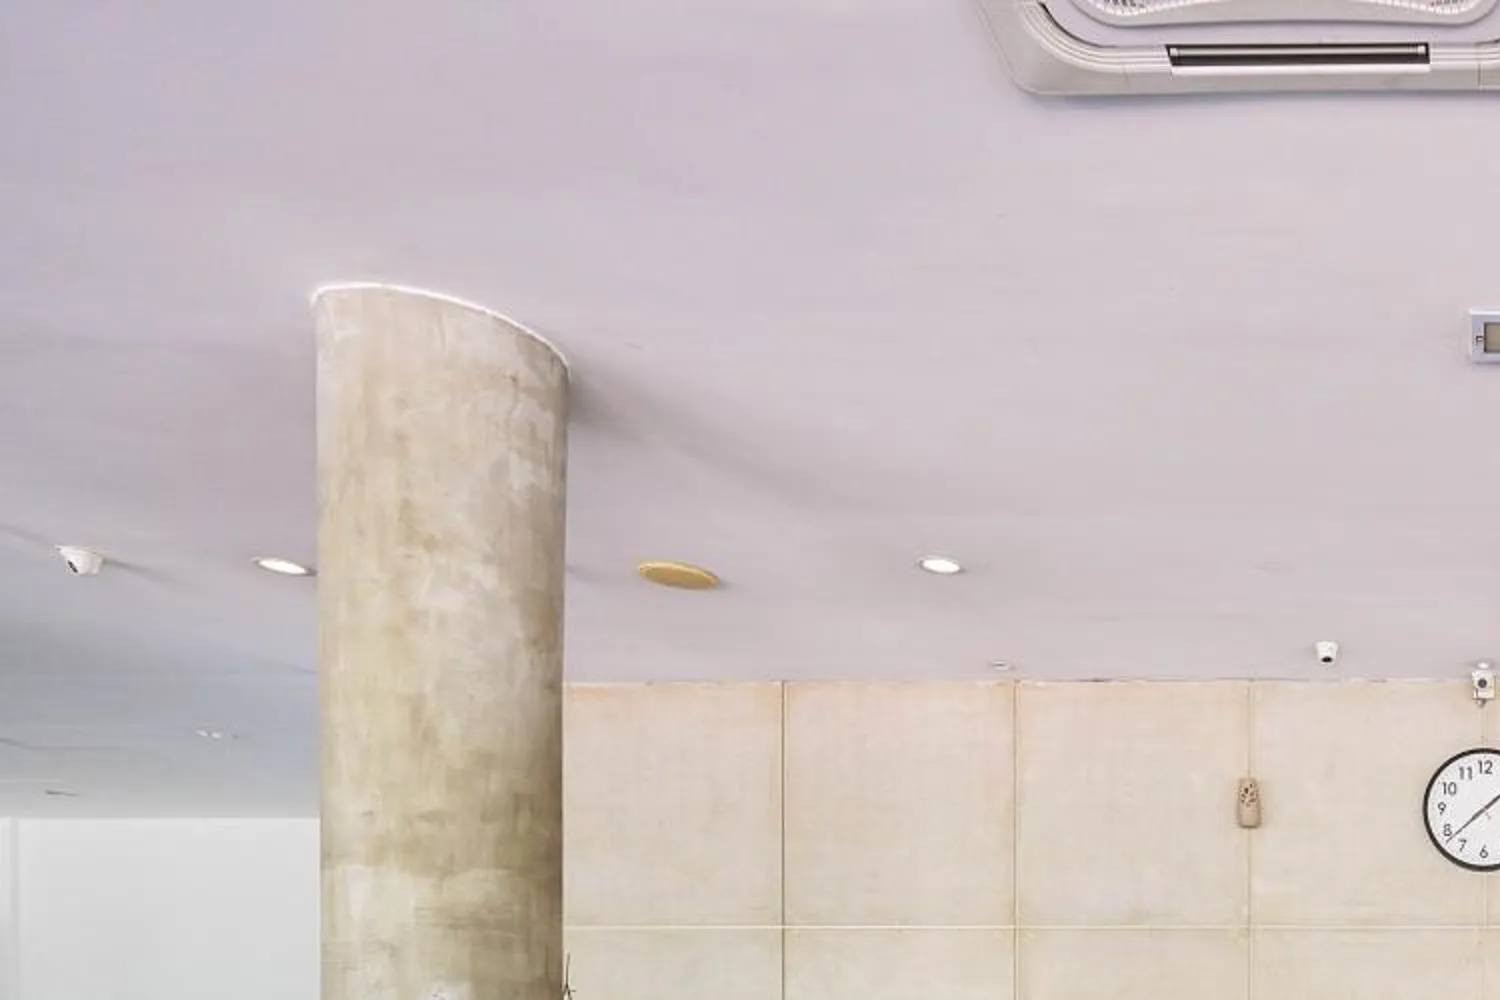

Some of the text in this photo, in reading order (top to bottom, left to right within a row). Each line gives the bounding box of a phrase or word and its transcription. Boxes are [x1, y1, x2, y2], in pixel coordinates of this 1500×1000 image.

[1458, 766, 1473, 780] 11
[1478, 760, 1493, 775] 12
[1442, 782, 1457, 796] 10
[1437, 801, 1447, 815] 9
[1443, 824, 1452, 837] 8
[1458, 838, 1467, 852] 7
[1479, 844, 1489, 858] 6
